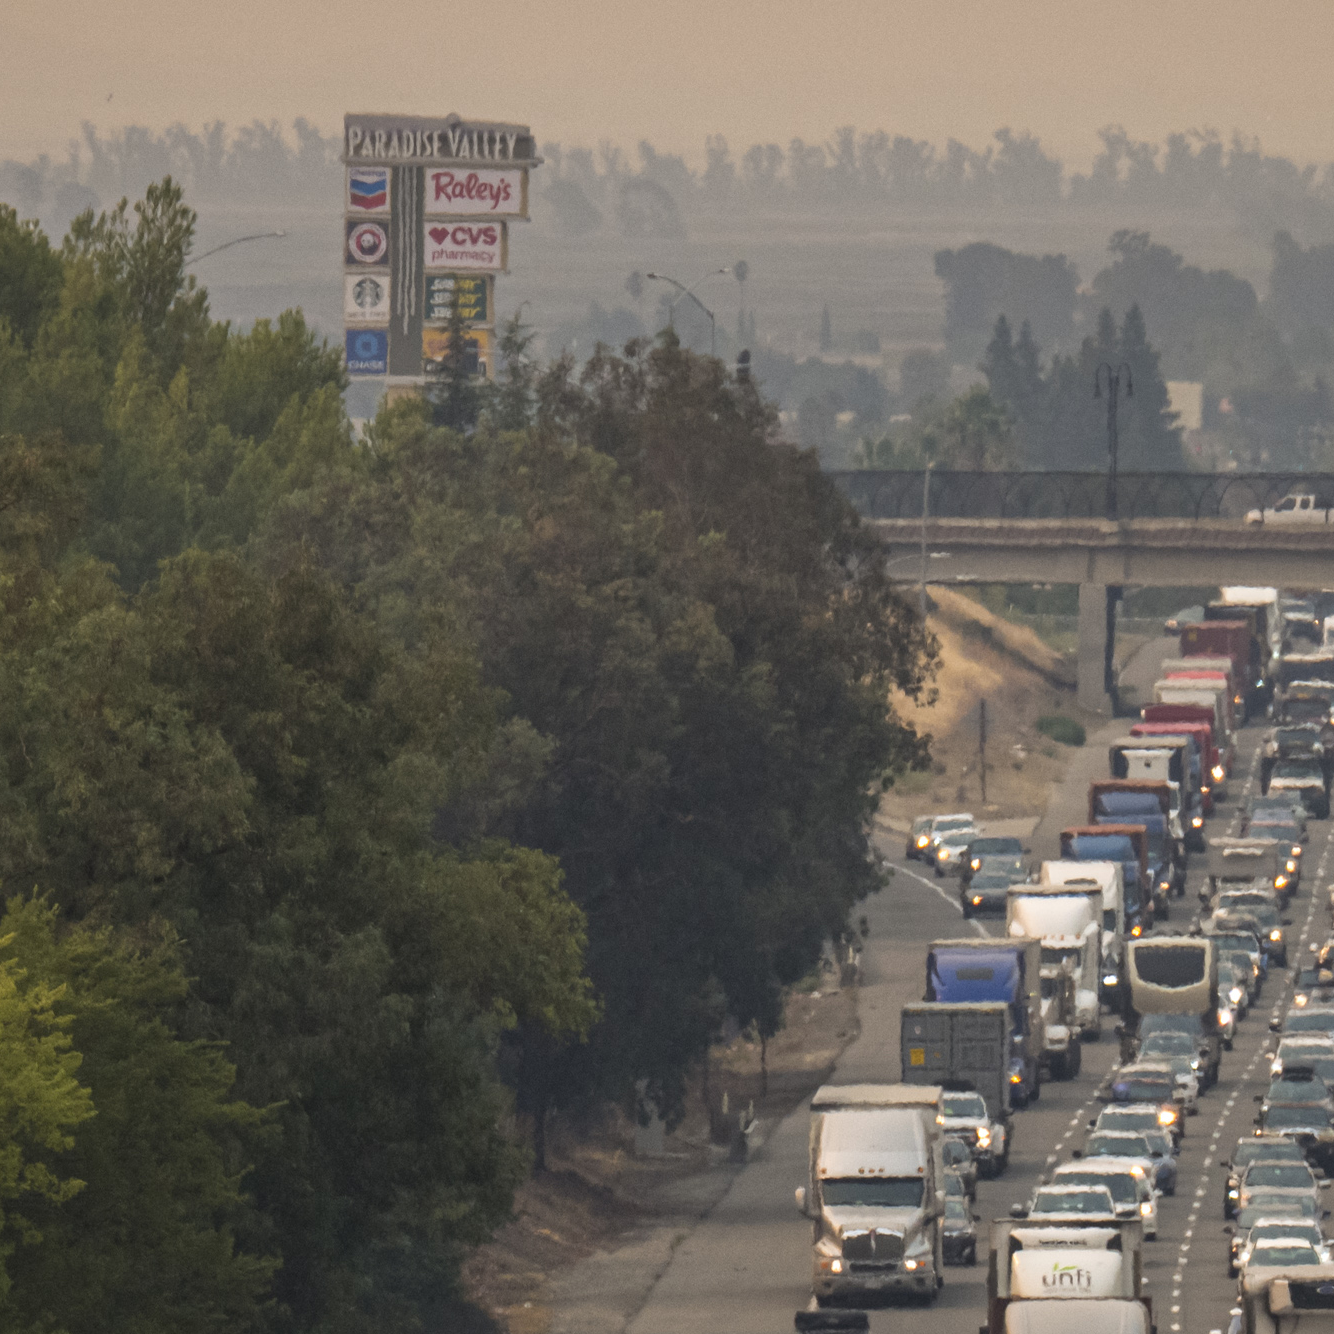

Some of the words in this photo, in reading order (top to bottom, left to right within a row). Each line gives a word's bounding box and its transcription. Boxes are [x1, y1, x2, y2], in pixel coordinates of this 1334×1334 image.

[348, 127, 443, 158] PARADISE
[447, 128, 516, 160] VALLEY
[431, 171, 511, 210] Raley's
[451, 226, 497, 246] CVS
[432, 248, 495, 263] pharmacy
